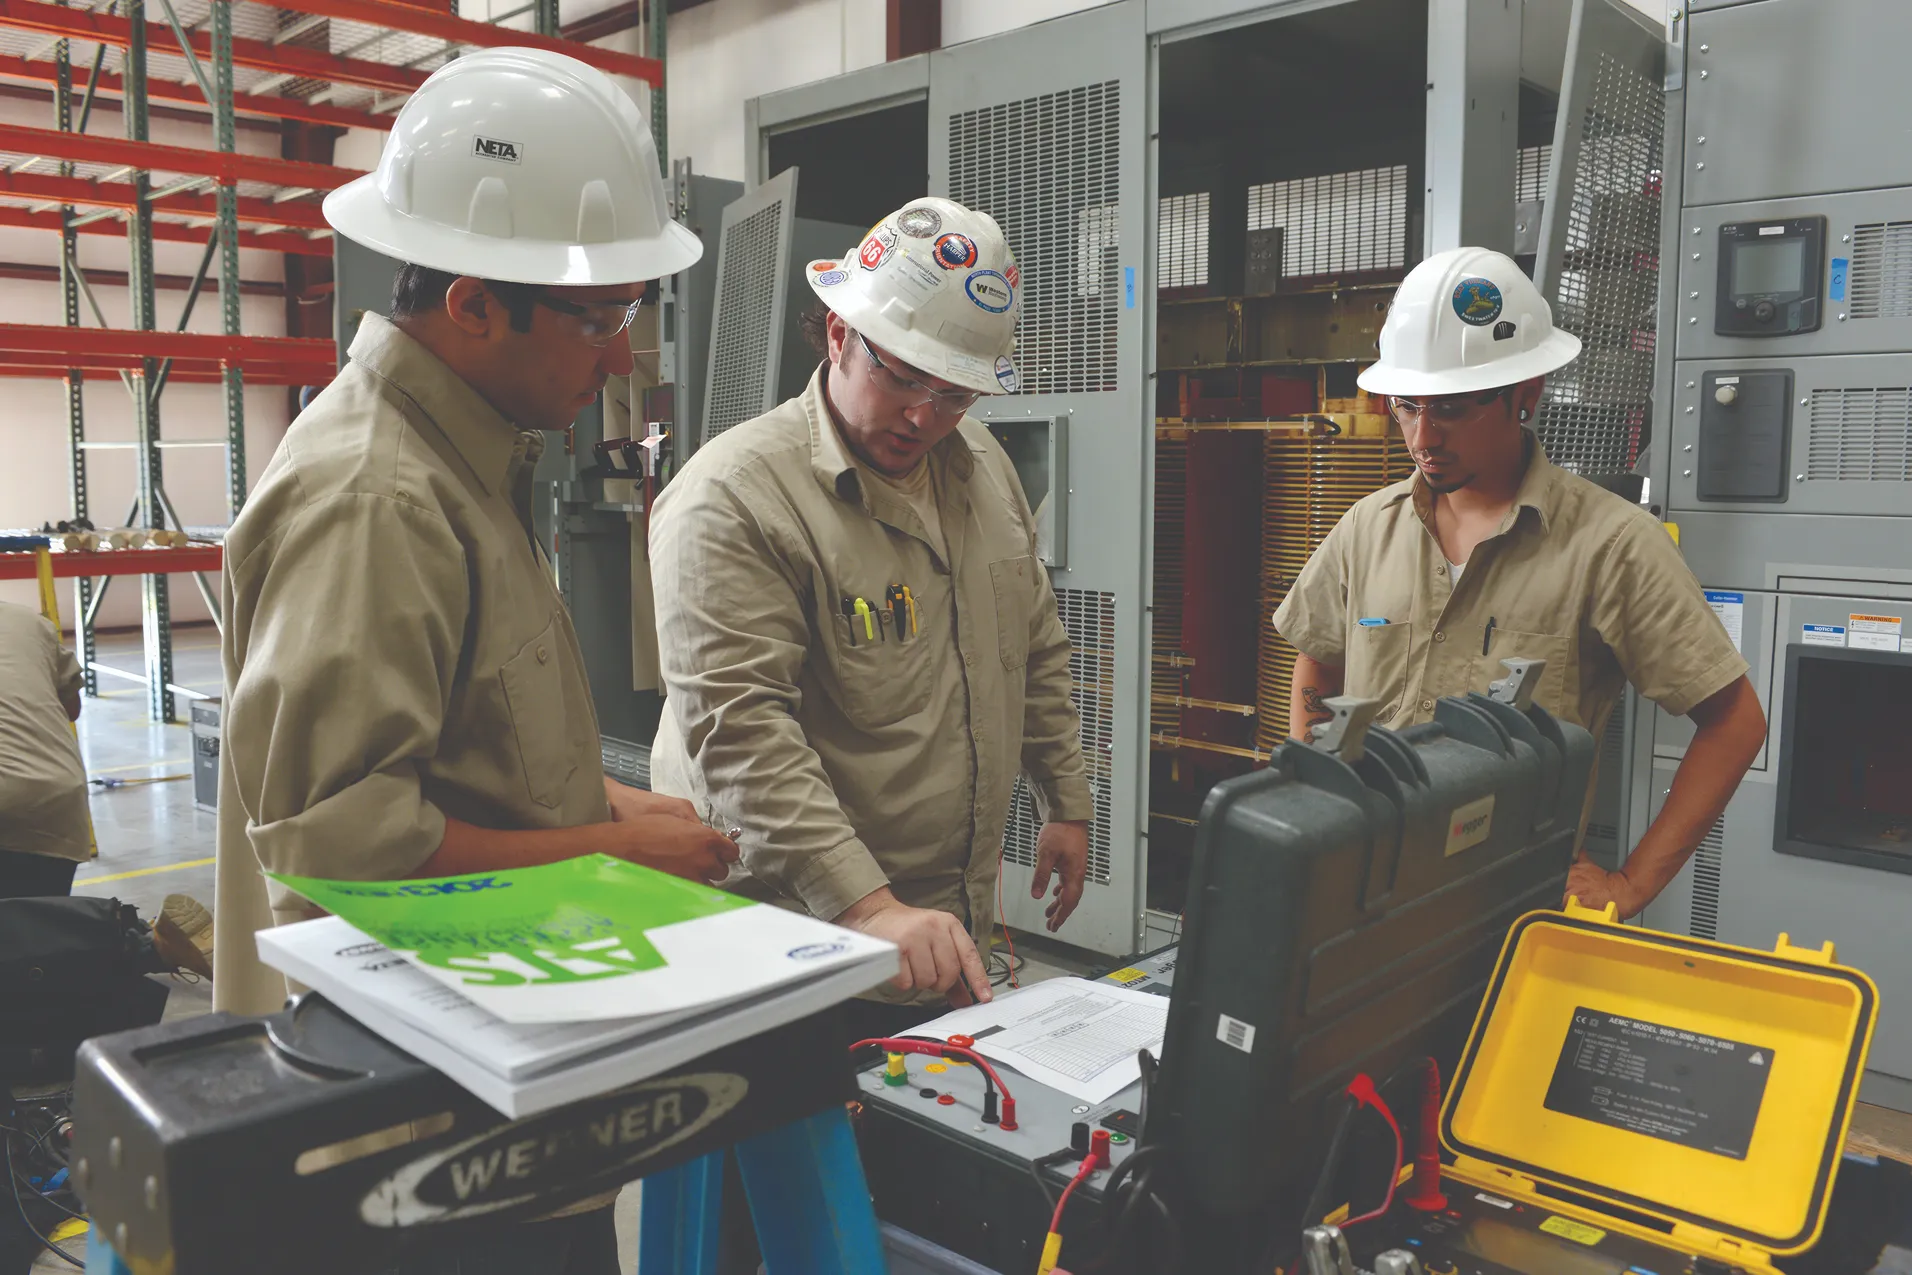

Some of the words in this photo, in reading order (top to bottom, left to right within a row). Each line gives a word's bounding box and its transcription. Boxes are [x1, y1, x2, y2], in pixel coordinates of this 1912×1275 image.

[475, 138, 517, 158] NETA
[862, 240, 882, 262] 66
[943, 242, 966, 261] HARPER
[1833, 274, 1842, 284] C
[1158, 960, 1176, 974] ger
[1608, 1017, 1629, 1027] AEMC
[1633, 1022, 1657, 1035] MODEL
